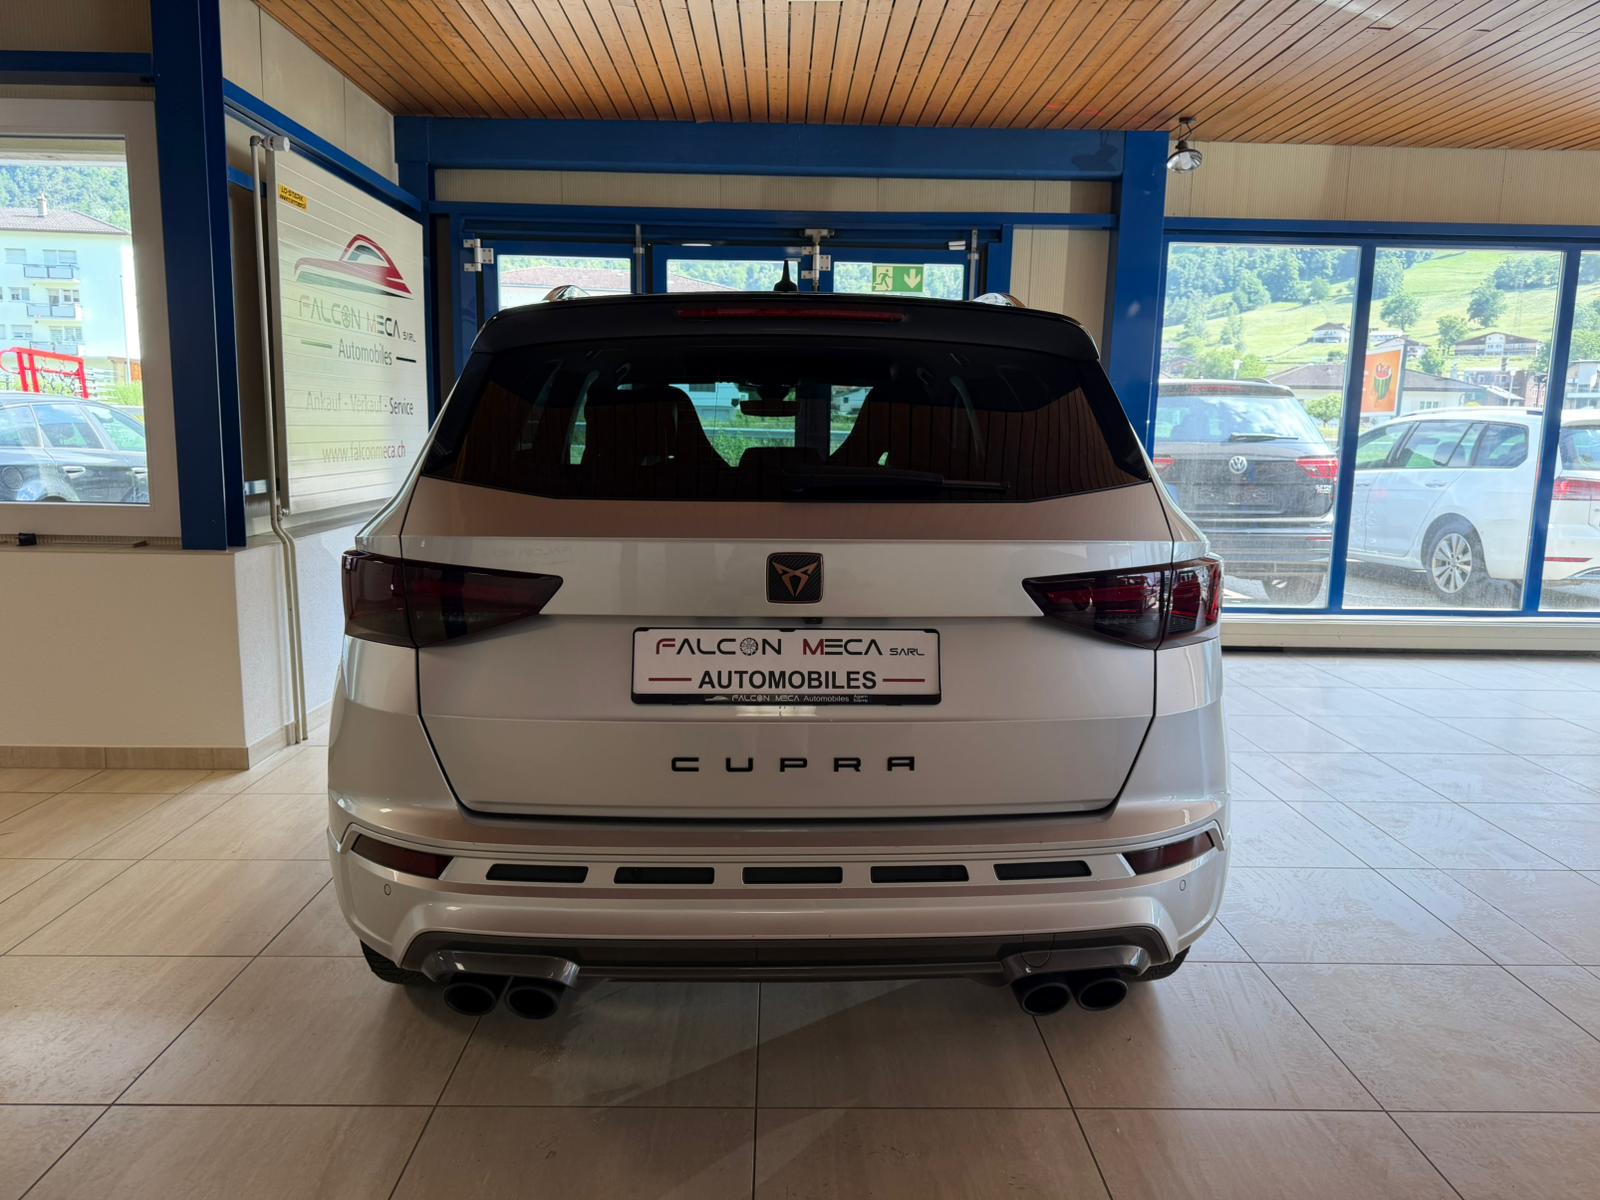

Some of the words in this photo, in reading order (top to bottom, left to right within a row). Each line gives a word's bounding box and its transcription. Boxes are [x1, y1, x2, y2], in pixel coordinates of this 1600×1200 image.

[300, 295, 361, 329] FALCON
[366, 311, 400, 338] MECA
[338, 339, 393, 366] Automobiles
[306, 391, 341, 411] Ankauf
[350, 394, 384, 412] Verkauf
[389, 396, 414, 415] Service
[322, 441, 406, 463] www.falconmeca.ch
[656, 637, 782, 656] FALCON
[802, 638, 883, 656] MECA
[889, 647, 925, 656] SARL
[698, 670, 877, 689] AUTOMOBILES
[731, 694, 770, 702] FALCON
[803, 694, 850, 702] Automobiles
[671, 756, 915, 773] CUPRA
